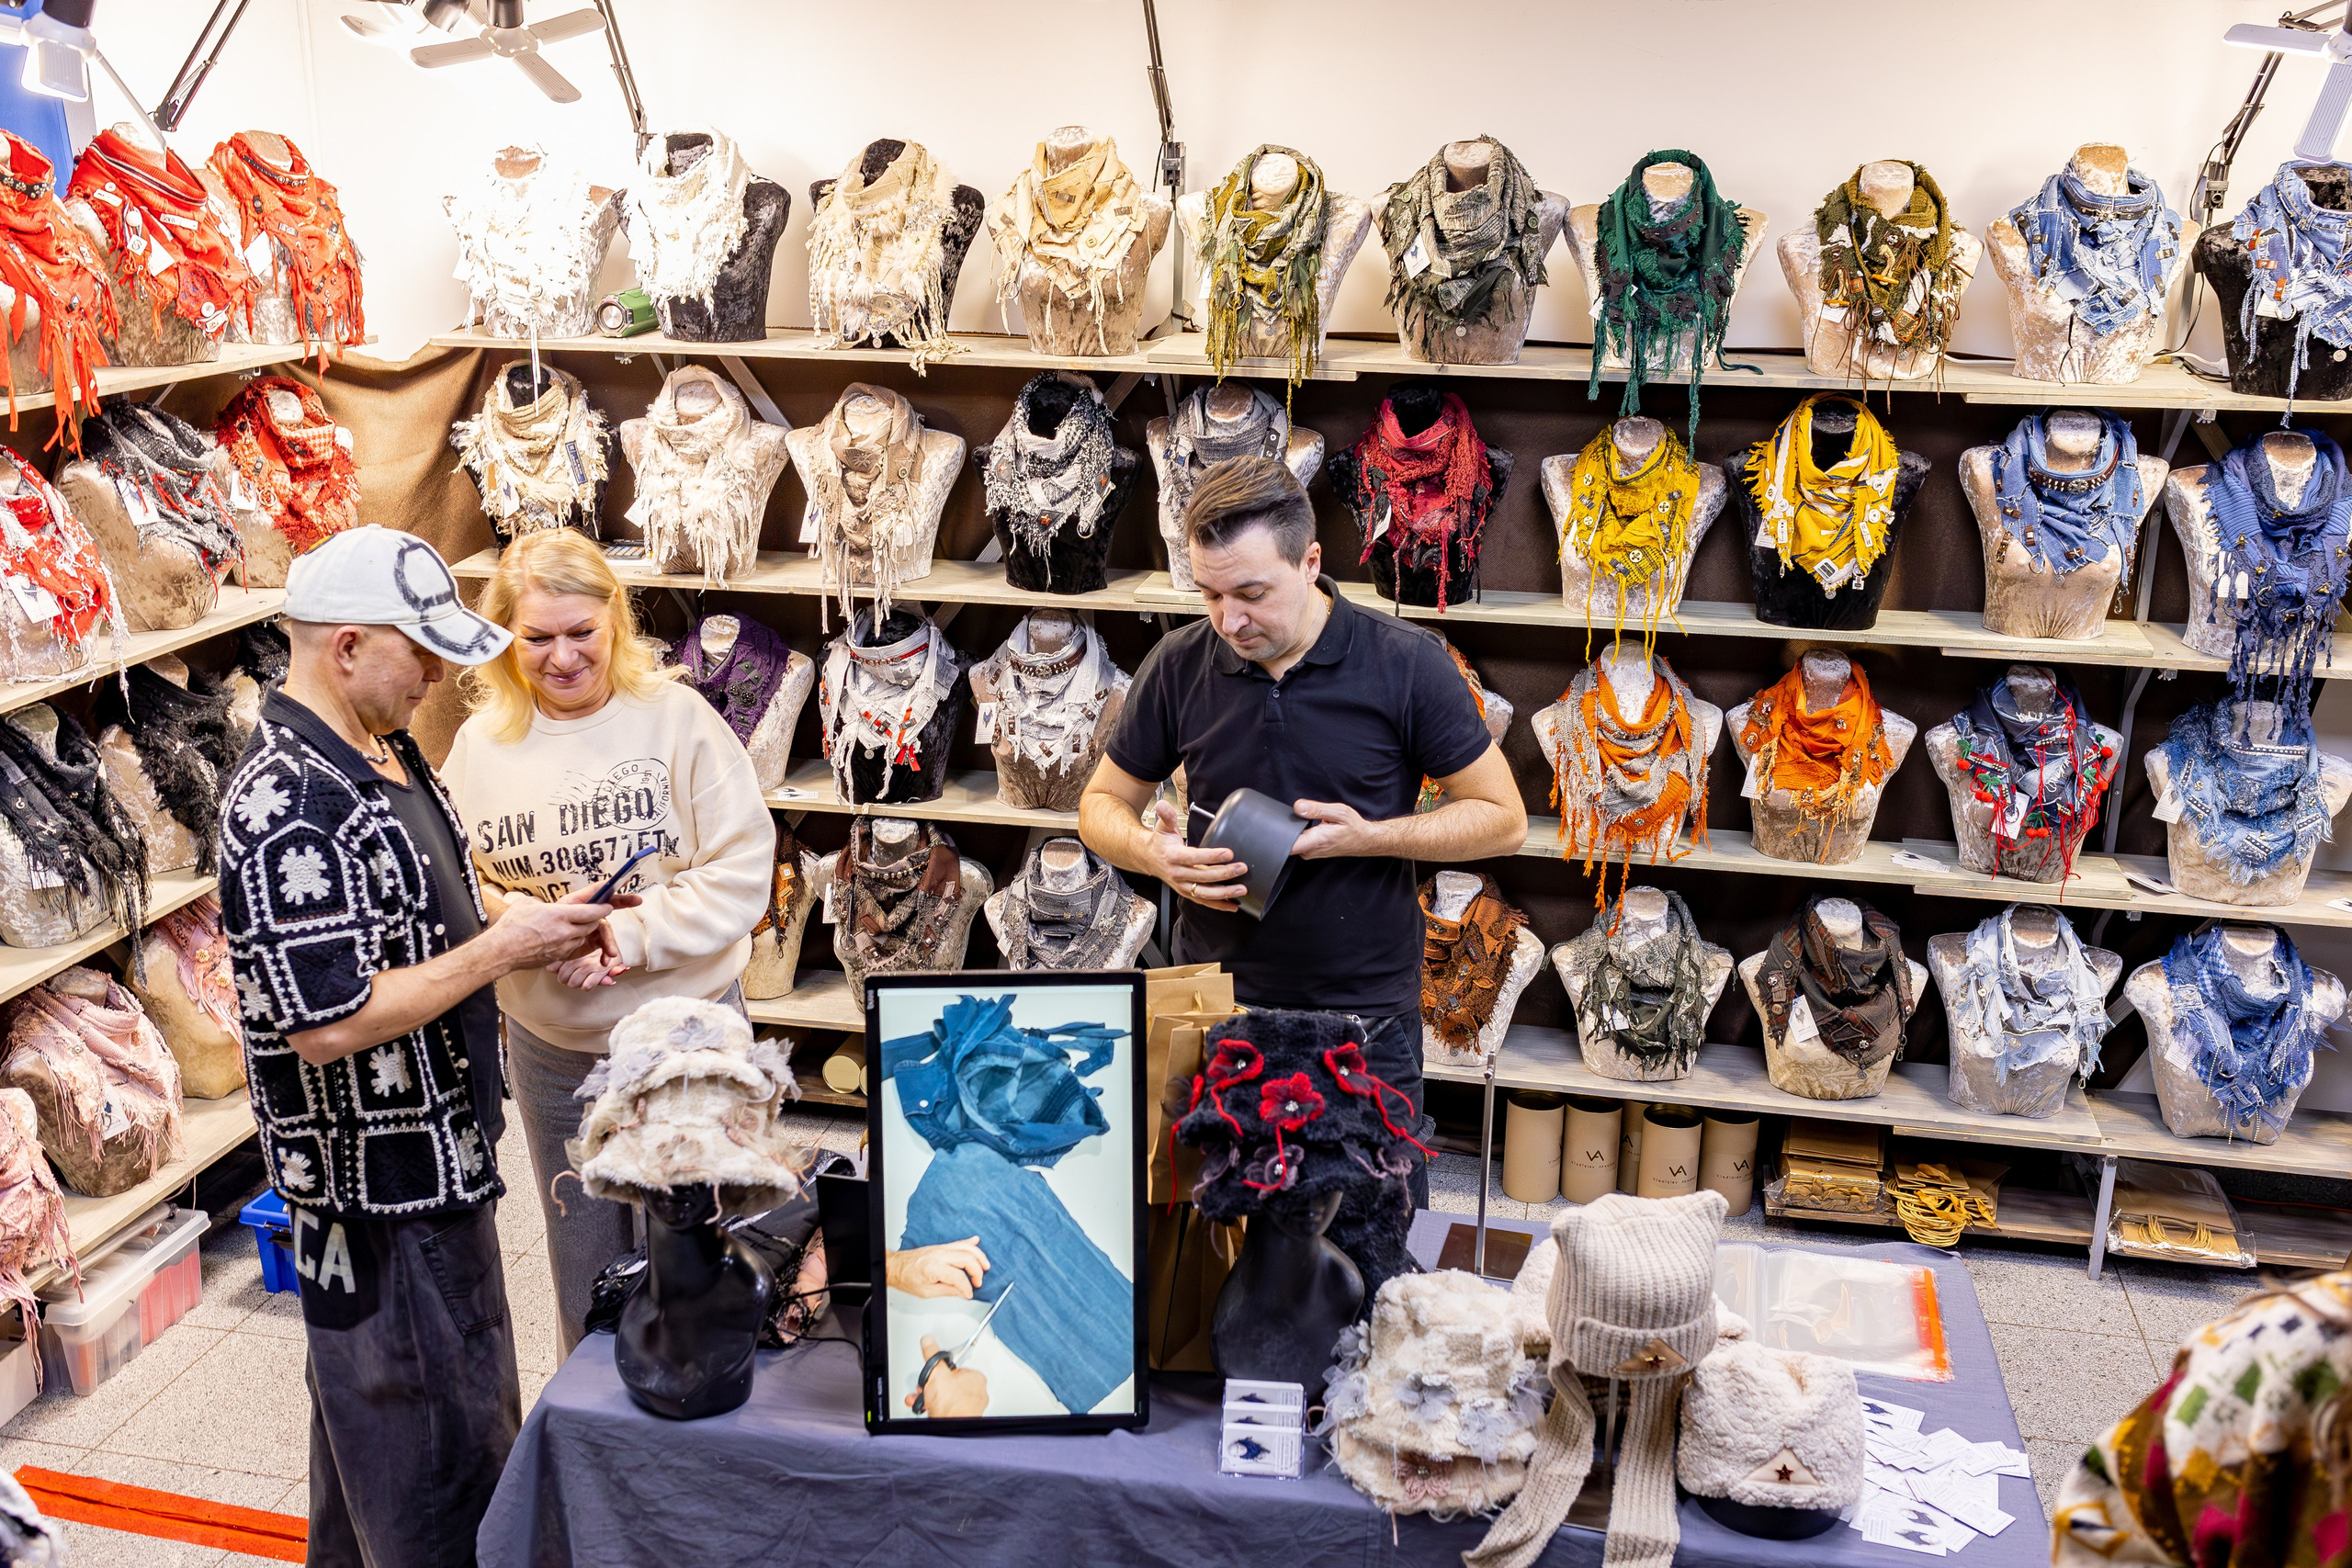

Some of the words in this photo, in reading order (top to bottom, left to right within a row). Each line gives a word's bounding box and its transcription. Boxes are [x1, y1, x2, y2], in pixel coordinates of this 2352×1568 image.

[477, 811, 536, 853] SAN
[560, 787, 653, 836] DIEGO
[1586, 1150, 1604, 1161] VA
[1668, 1165, 1687, 1177] VA
[1733, 1159, 1749, 1171] VA
